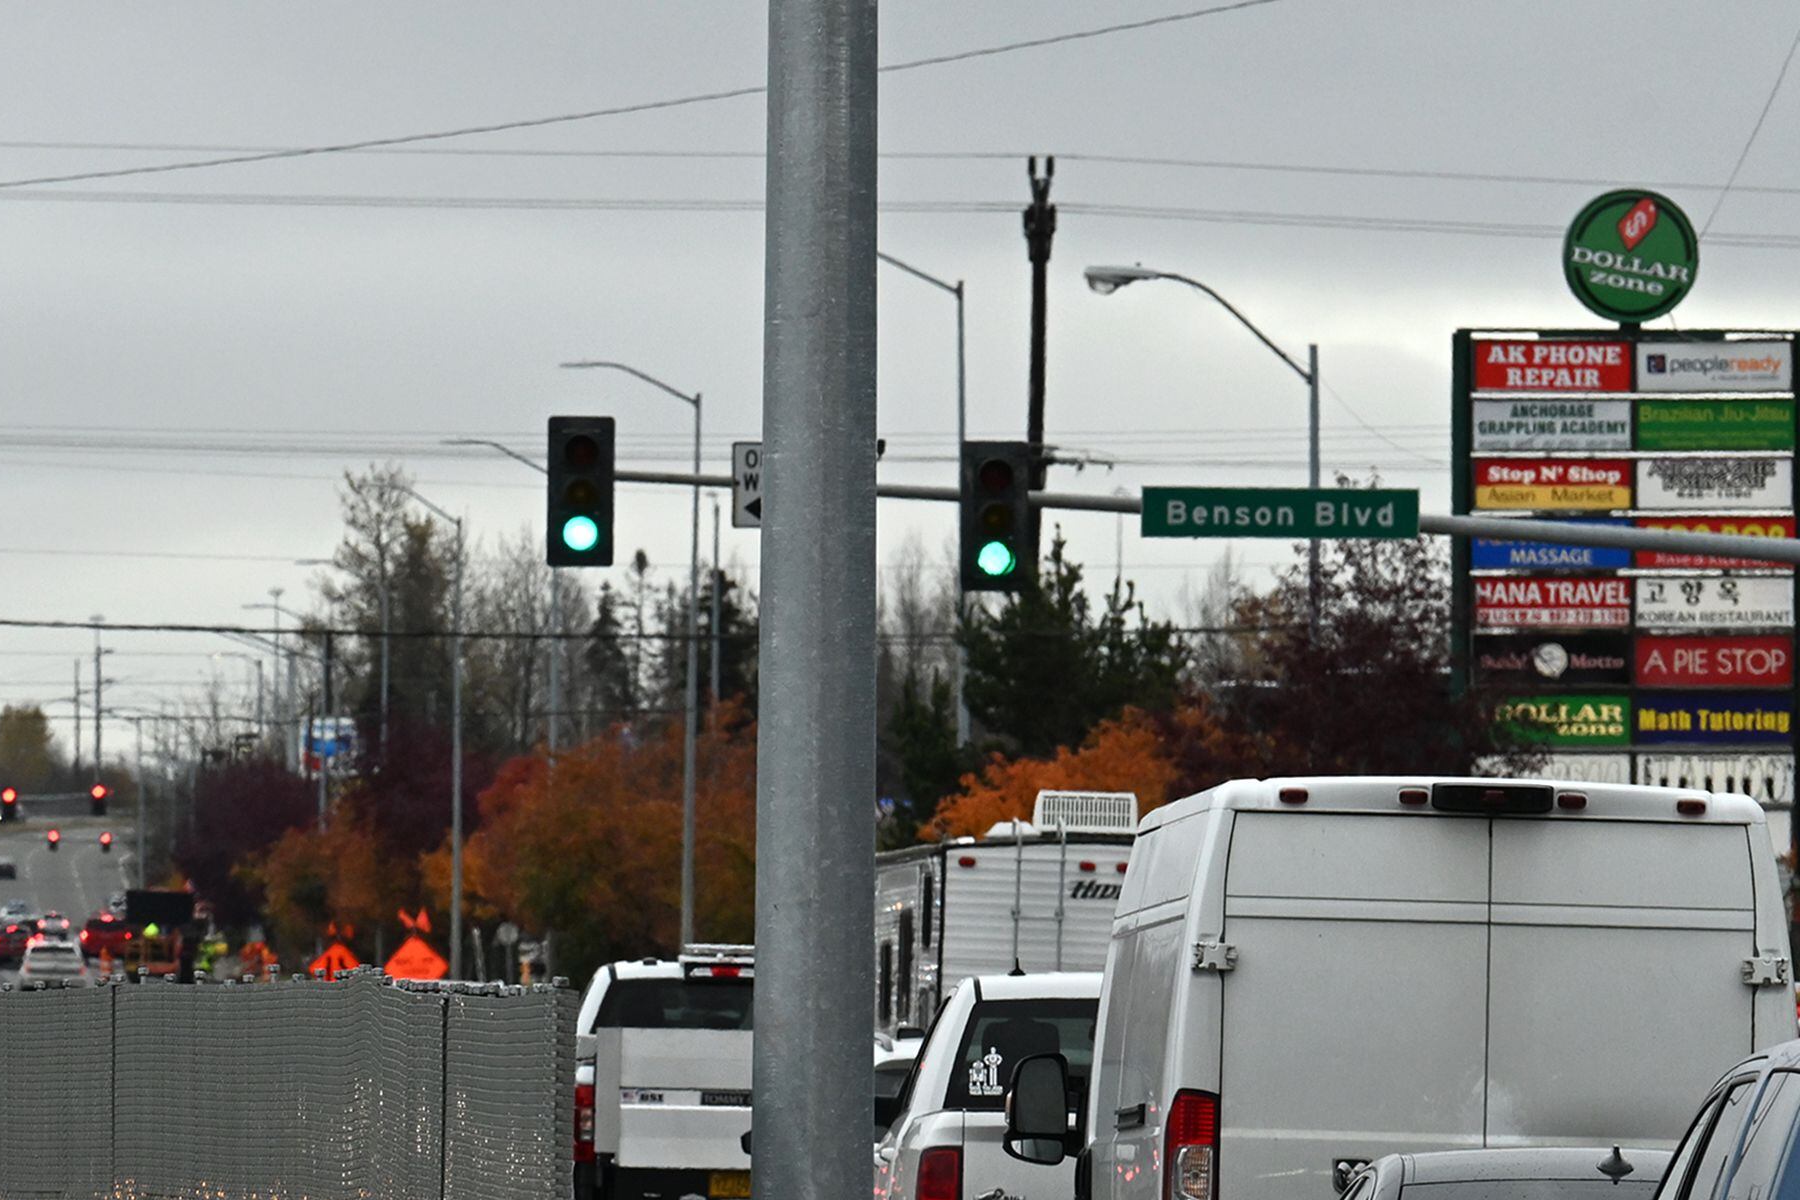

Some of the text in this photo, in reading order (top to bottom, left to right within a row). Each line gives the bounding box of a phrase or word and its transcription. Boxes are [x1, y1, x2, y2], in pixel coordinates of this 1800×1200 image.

[1570, 246, 1690, 282] DOLLAR
[1589, 270, 1665, 295] zone
[1487, 346, 1621, 365] AK PHONE
[1669, 355, 1782, 375] peopleready
[1506, 368, 1601, 387] REPAIR
[1510, 404, 1594, 418] ANCHORAGE
[1478, 421, 1627, 435] GRAPPLING ACADEMY
[1487, 466, 1536, 485] Stop
[1567, 466, 1622, 485] Shop
[1489, 488, 1614, 501] Asian Market
[1166, 500, 1395, 528] Benson Blvd
[1510, 549, 1593, 565] MASSAGE
[1475, 582, 1631, 604] HANA TRAVEL
[1637, 610, 1696, 622] KOREAN
[1699, 610, 1790, 622] RESTAURANT
[1570, 653, 1625, 669] Motto
[1644, 648, 1786, 675] A PIE STOP
[1556, 723, 1625, 736] zone
[1638, 708, 1790, 733] Math Tutoring
